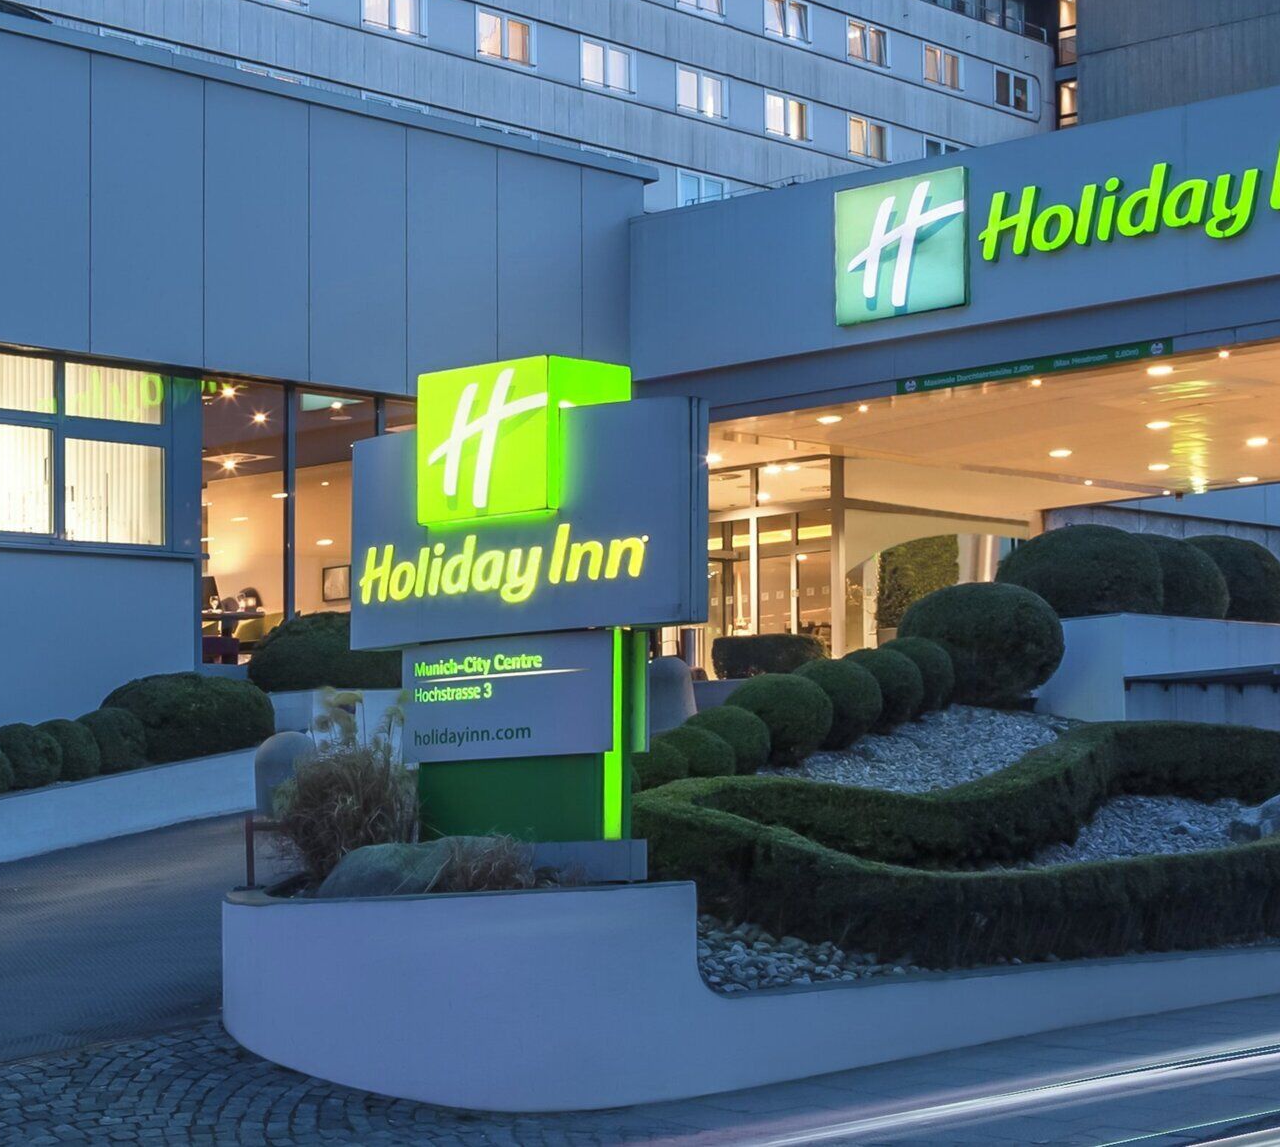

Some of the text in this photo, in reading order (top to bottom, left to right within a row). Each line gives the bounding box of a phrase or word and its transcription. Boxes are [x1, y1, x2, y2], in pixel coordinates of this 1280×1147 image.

[978, 162, 1263, 261] Holiday
[360, 523, 645, 604] Holiday Inn
[414, 654, 542, 676] Munich-City Centre
[414, 682, 492, 703] Hochstrasse 3
[414, 726, 531, 747] holidayinn.com
